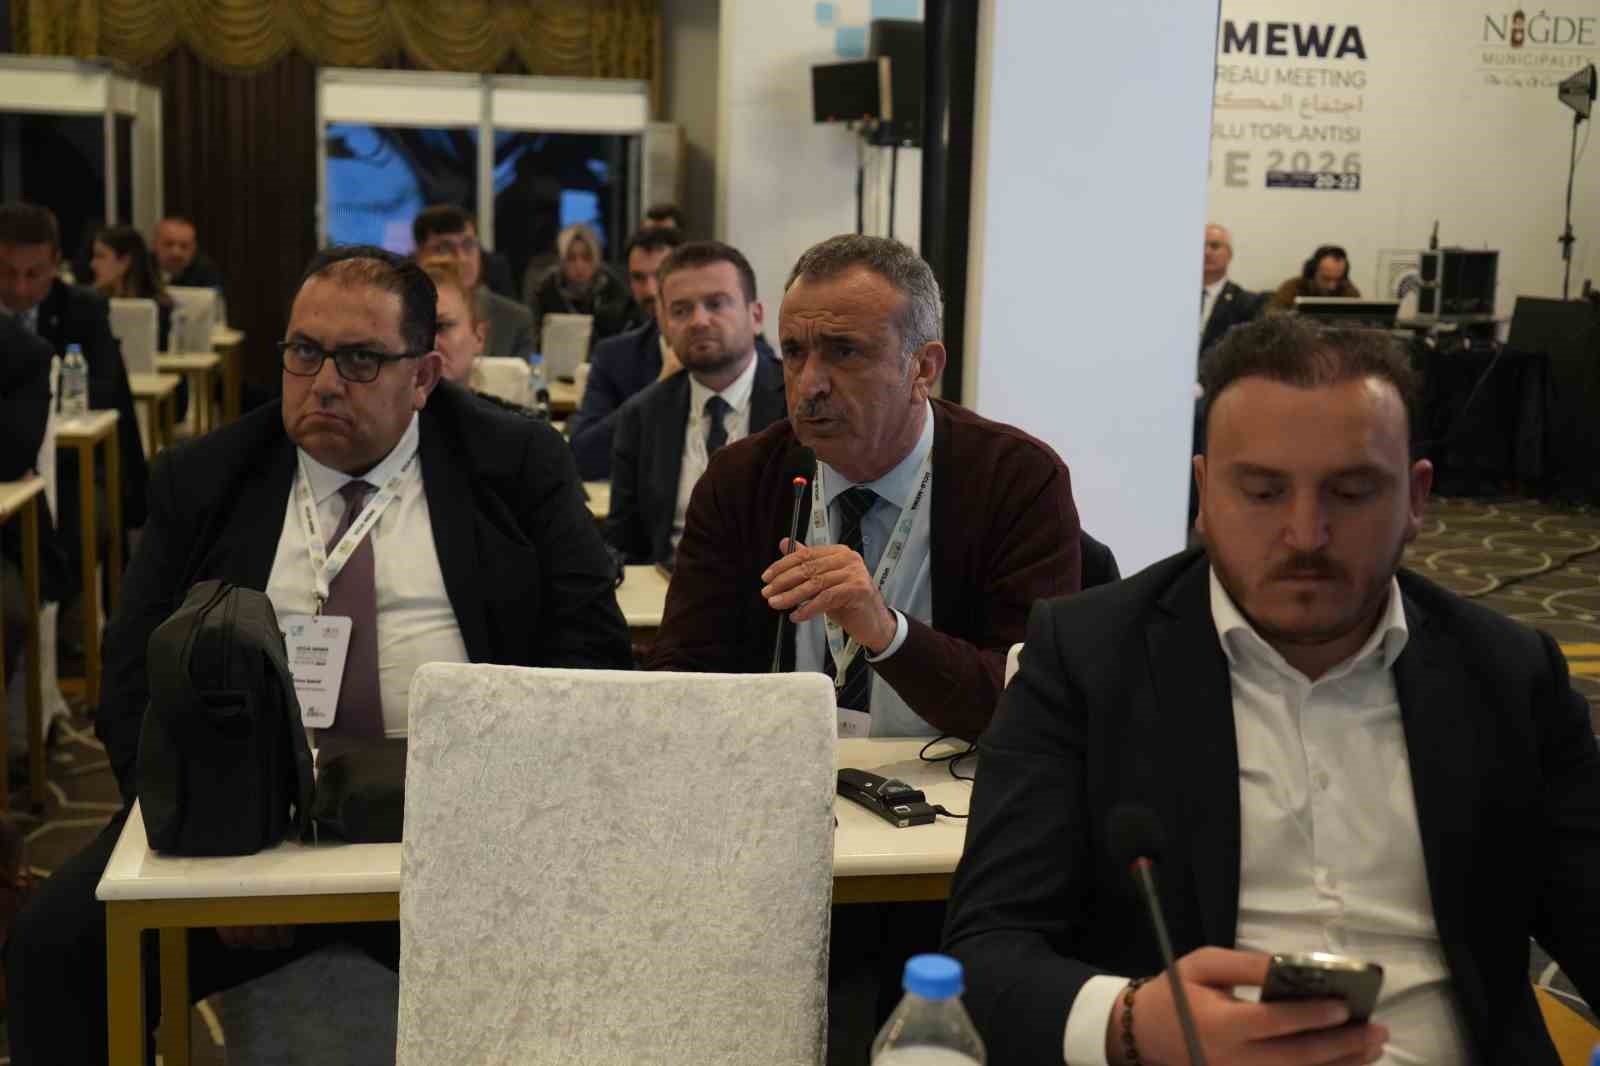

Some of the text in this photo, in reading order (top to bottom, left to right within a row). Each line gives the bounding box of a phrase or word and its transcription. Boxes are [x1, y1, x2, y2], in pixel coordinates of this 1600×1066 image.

[1223, 20, 1367, 60] MEWA
[1276, 67, 1367, 89] MEETING
[1249, 123, 1361, 143] TOPLANTISI
[1266, 150, 1361, 173] 2026
